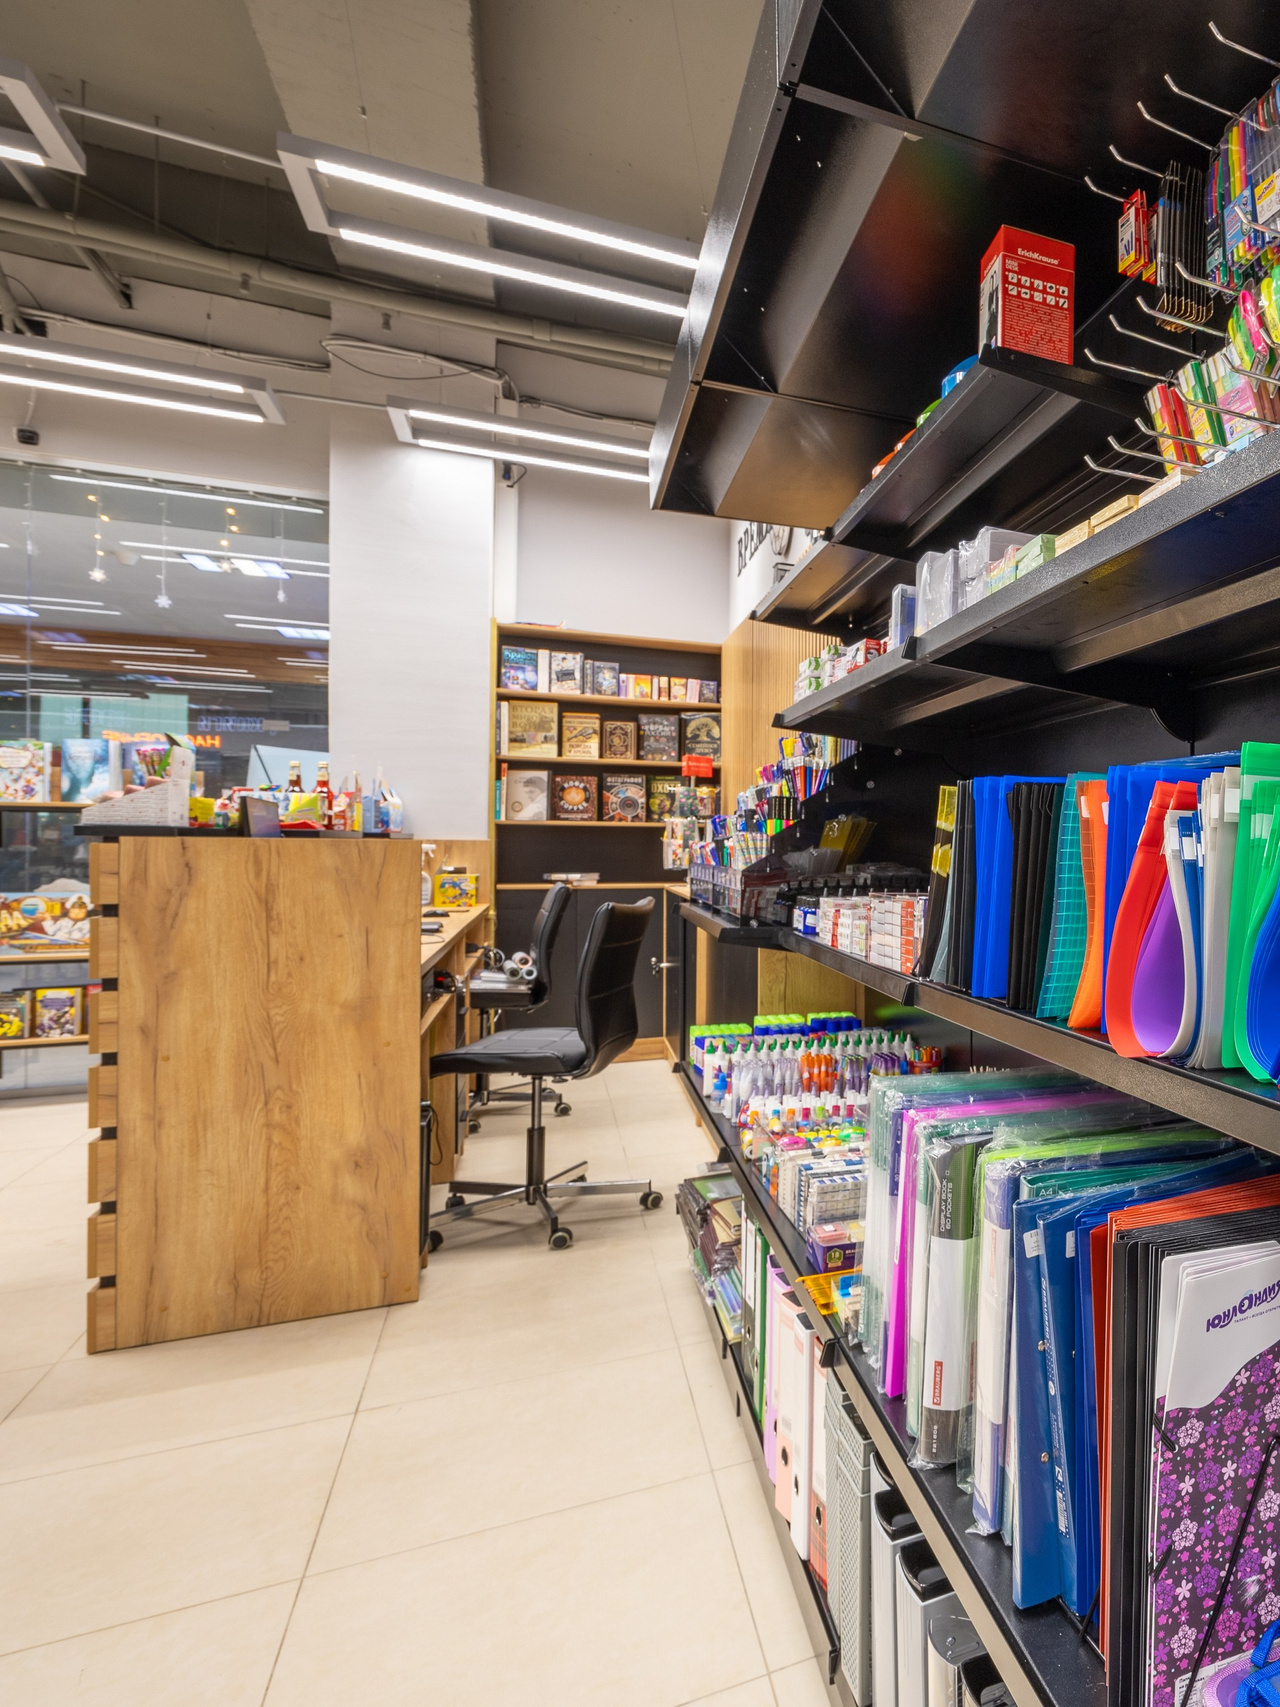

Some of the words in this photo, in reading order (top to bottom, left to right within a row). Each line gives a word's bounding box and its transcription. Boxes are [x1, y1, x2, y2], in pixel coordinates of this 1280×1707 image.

[1018, 248, 1059, 264] ErichKrause
[1005, 259, 1018, 267] MINI
[1005, 264, 1019, 272] DESK
[511, 704, 555, 715] ВТОРАЯ
[563, 780, 585, 789] КОФЕ
[559, 801, 589, 811] COFFEE
[1039, 1187, 1053, 1196] A4
[945, 1219, 951, 1230] 60
